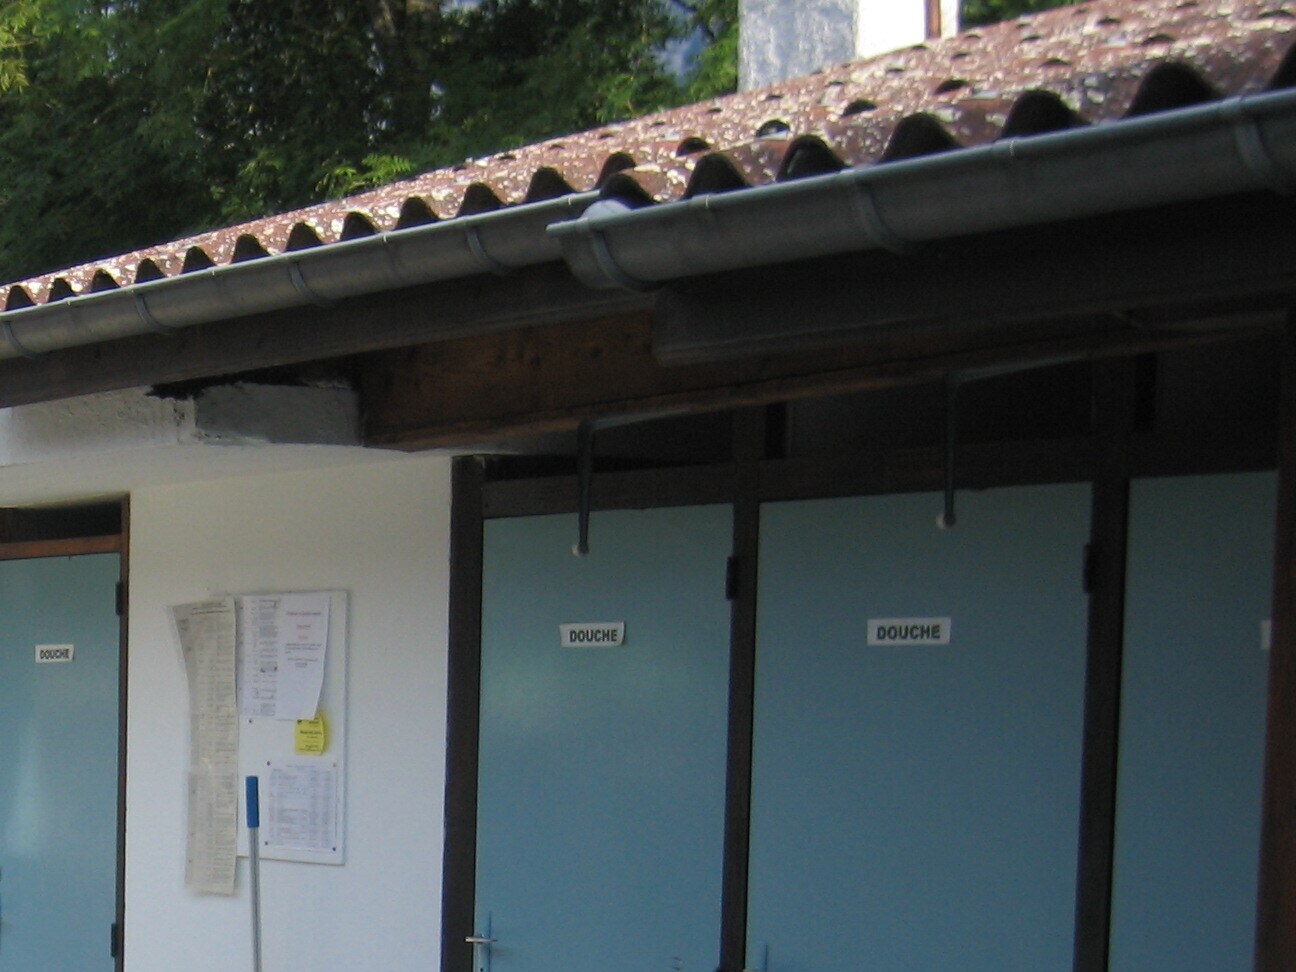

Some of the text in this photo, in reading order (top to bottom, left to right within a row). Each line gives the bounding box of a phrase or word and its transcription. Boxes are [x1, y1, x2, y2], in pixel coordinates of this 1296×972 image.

[569, 630, 618, 643] DOUCHE
[877, 624, 941, 640] DOUCHE
[39, 648, 70, 660] DOUCHE
